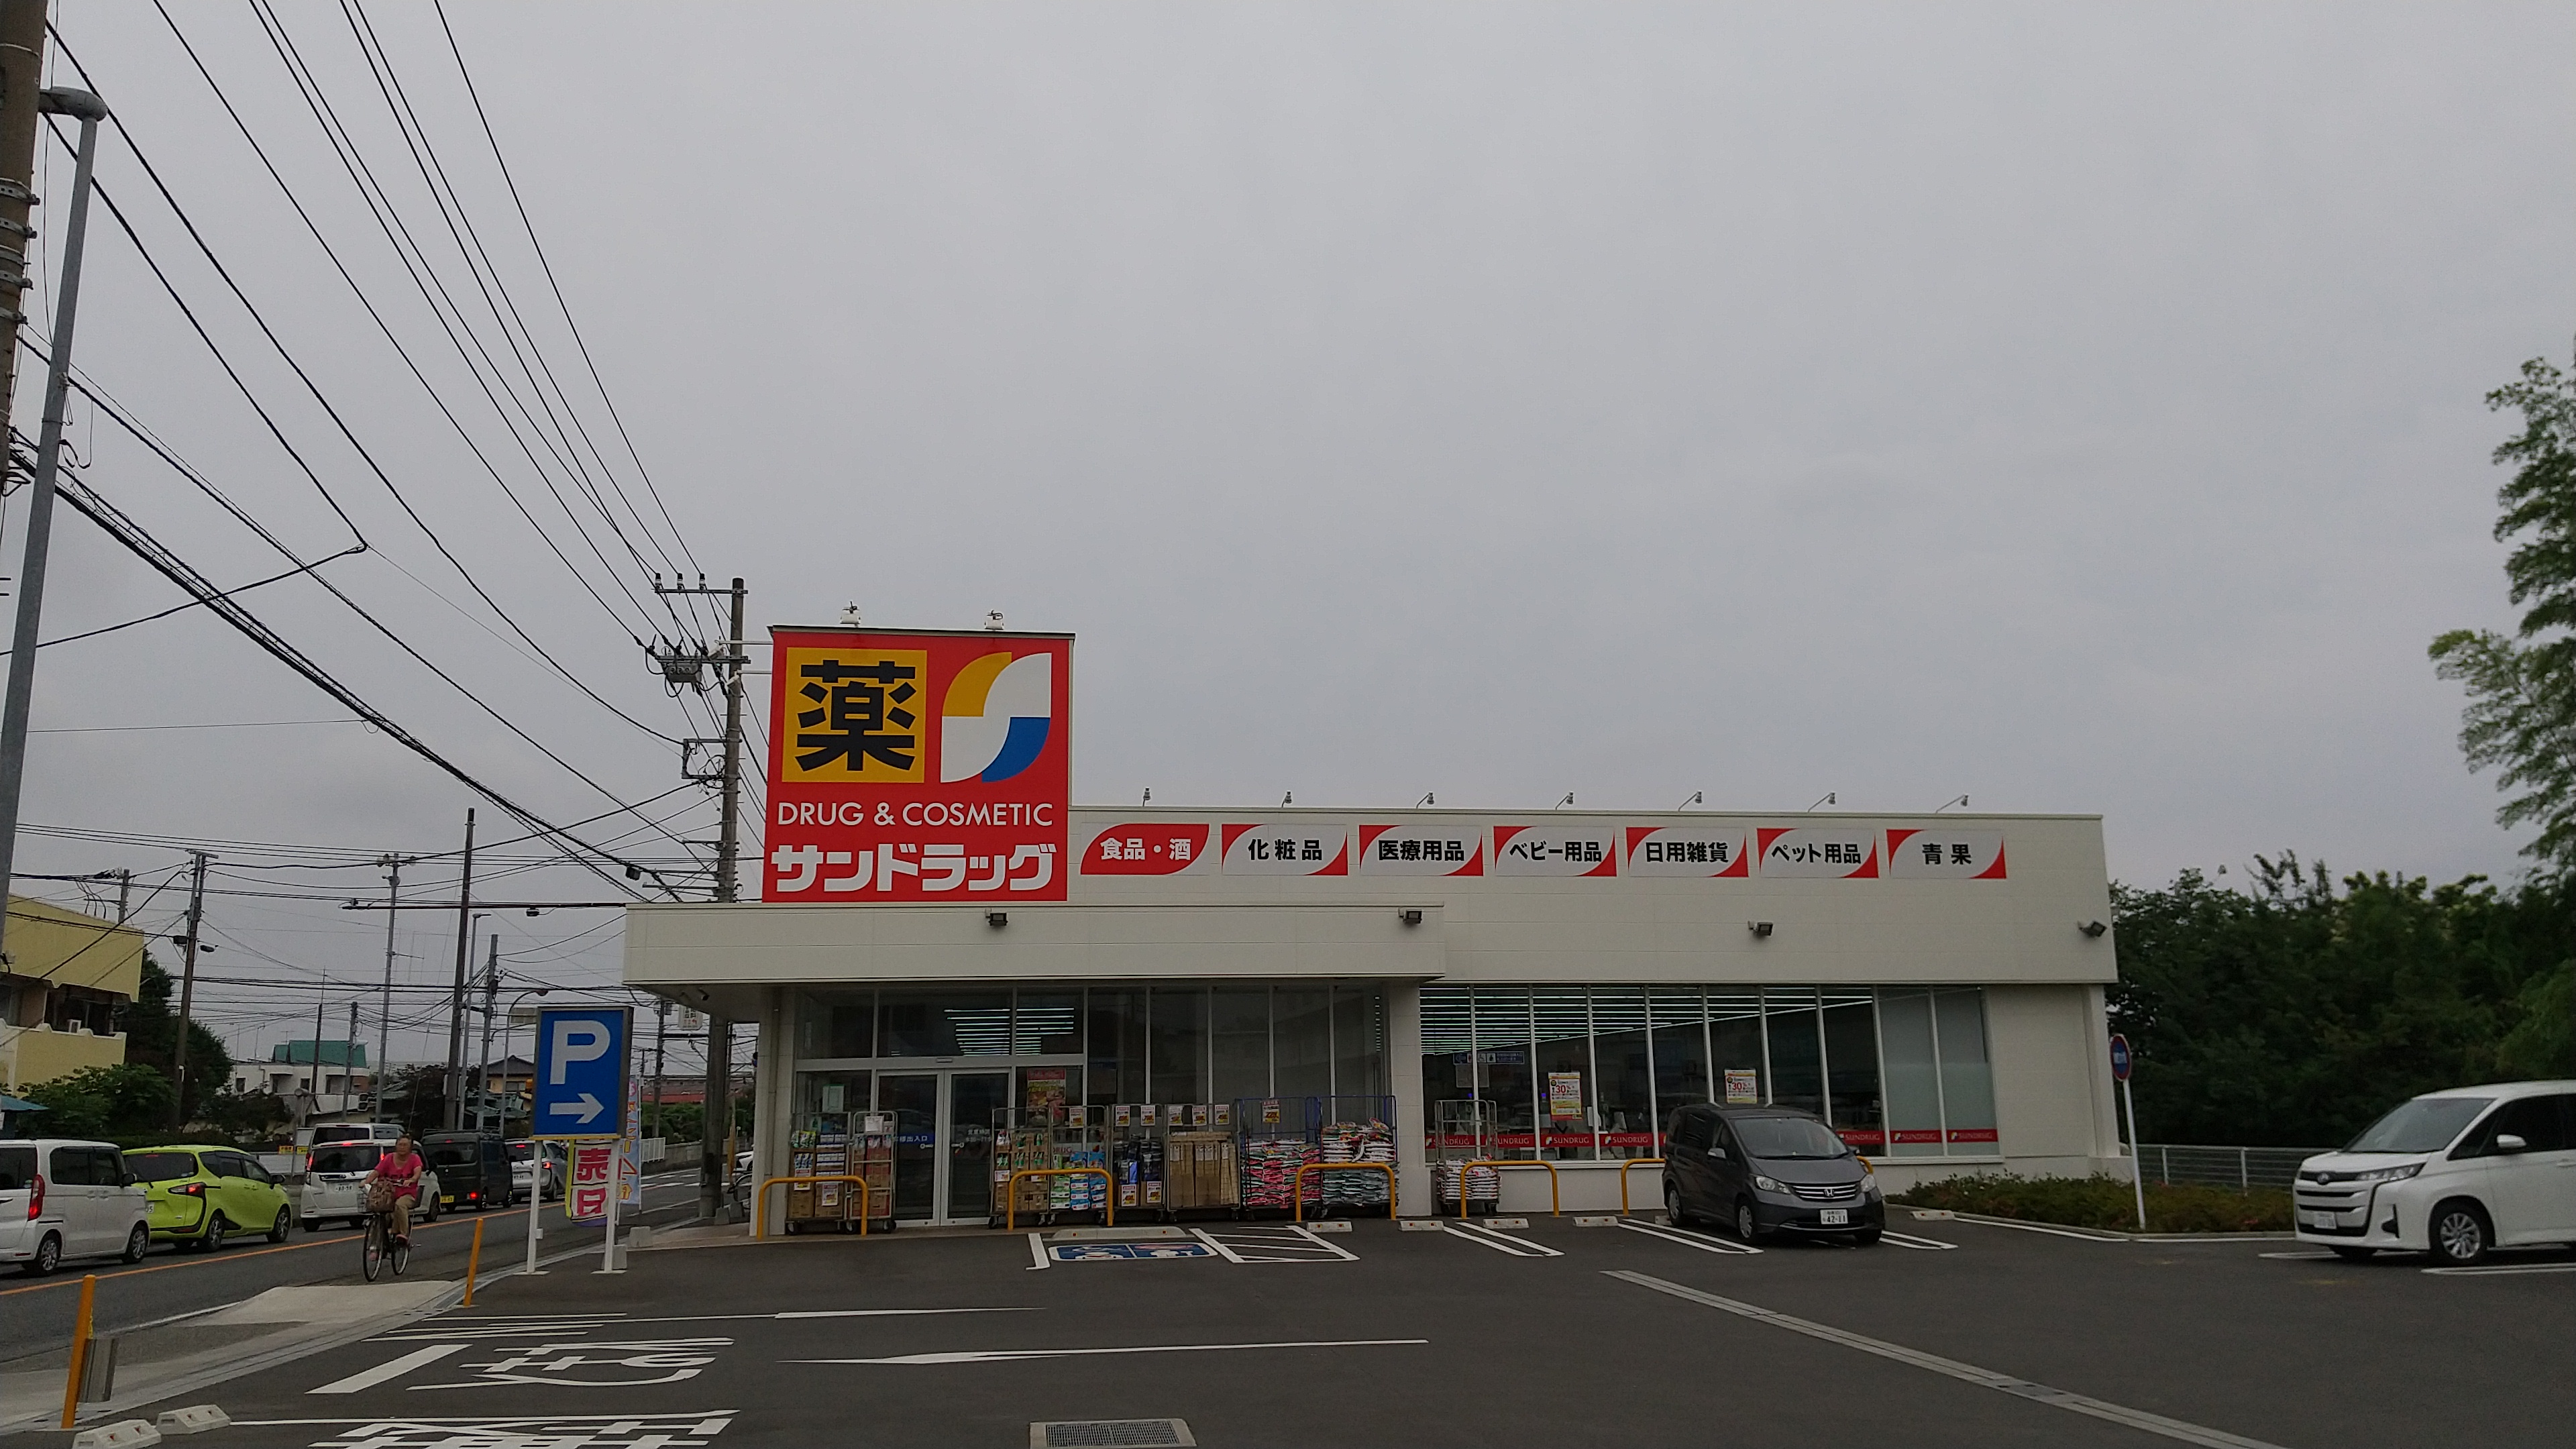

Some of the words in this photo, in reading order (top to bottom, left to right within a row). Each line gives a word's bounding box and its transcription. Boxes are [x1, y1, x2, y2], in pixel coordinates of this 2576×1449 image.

[795, 660, 916, 771] 薬
[778, 802, 865, 826] DRUG
[873, 803, 896, 826] &
[902, 802, 1053, 826] COSMETIC
[1099, 838, 1191, 861] 食品・酒
[1248, 839, 1323, 861] 化粧品
[1378, 839, 1465, 861] 医療用品
[1509, 841, 1603, 862] ベビー用品
[1645, 841, 1729, 863] 日用雑貨
[1771, 843, 1862, 864] ペット用品
[1922, 843, 1972, 865] 青果
[771, 843, 1057, 892] サンドラッグ
[549, 1020, 610, 1085] P
[576, 1139, 612, 1216] 売日
